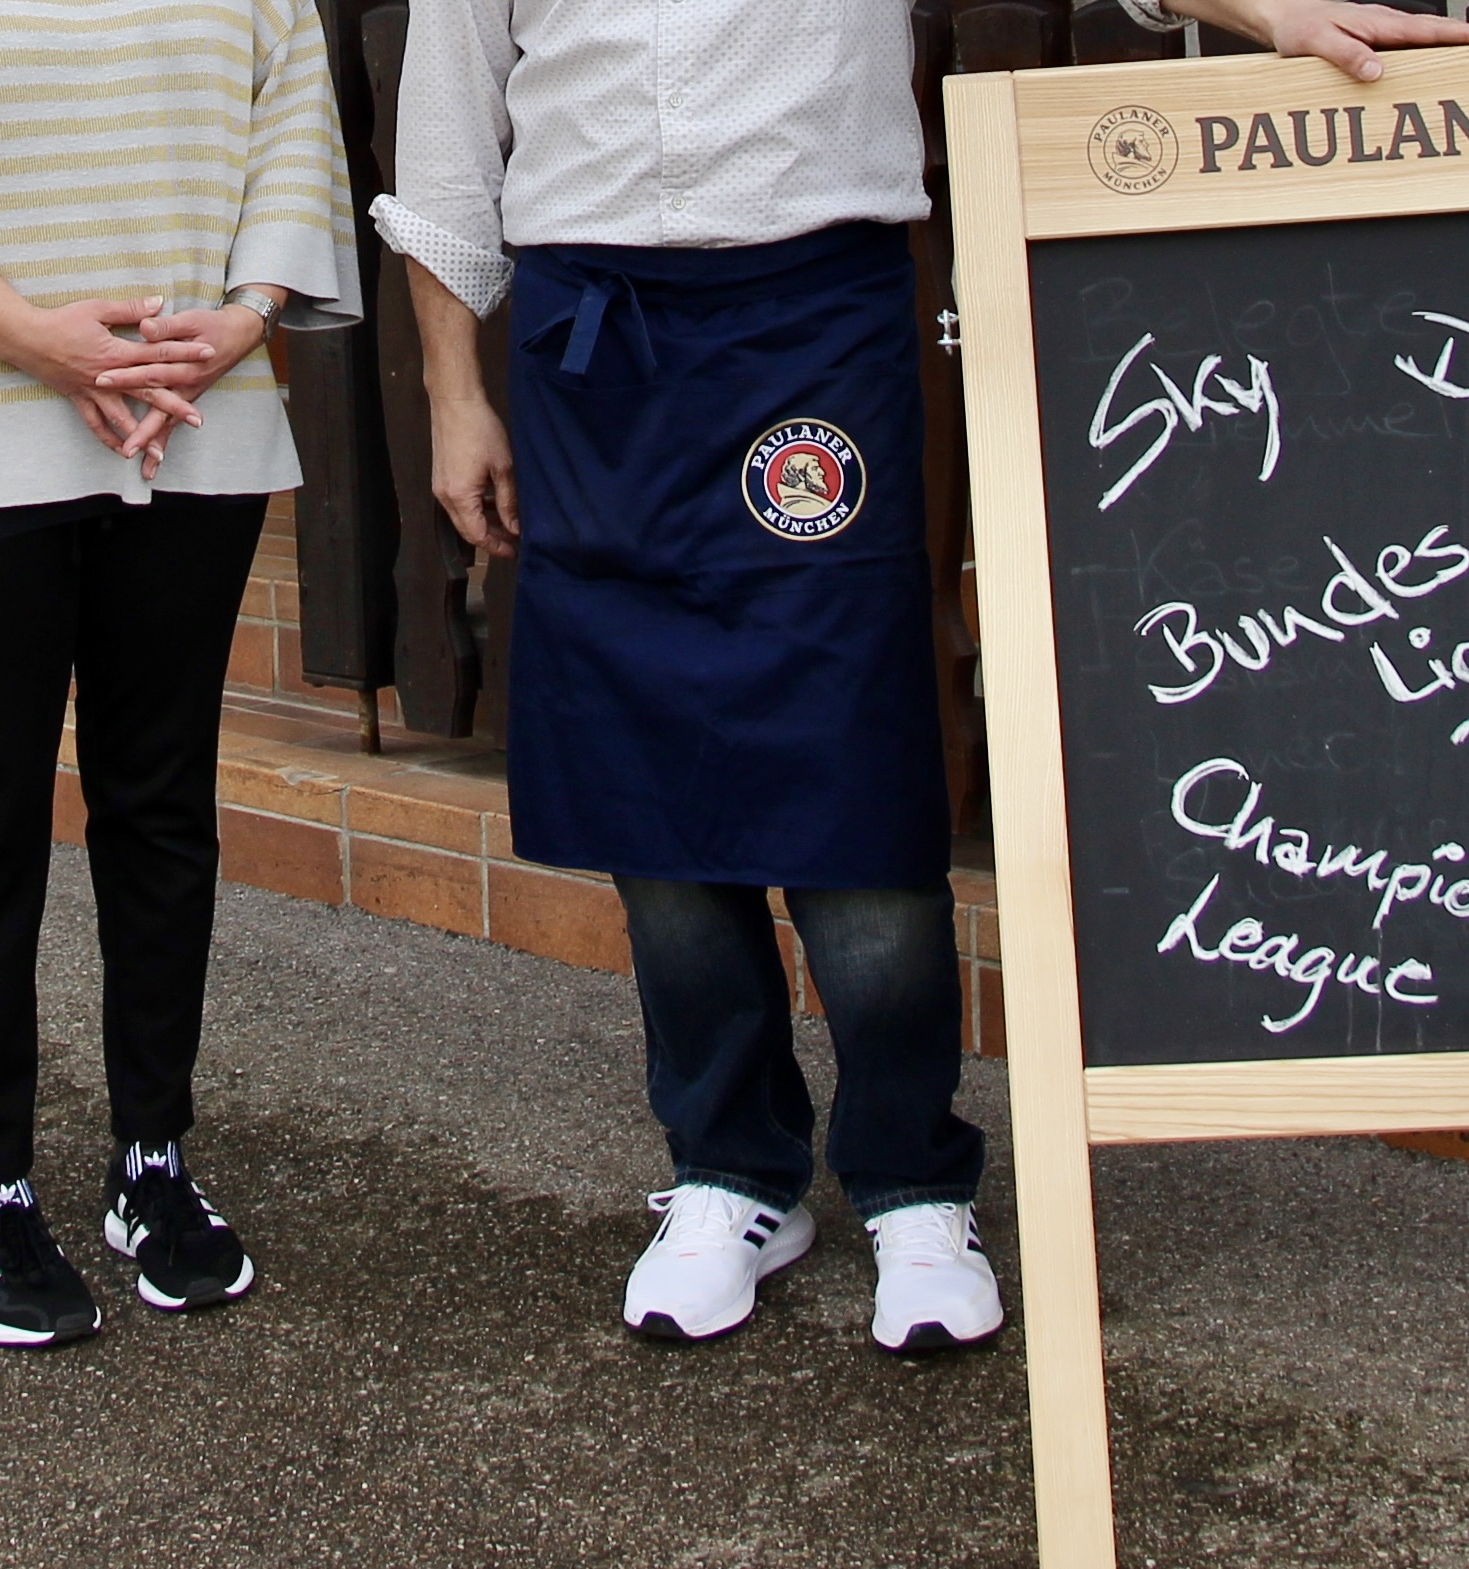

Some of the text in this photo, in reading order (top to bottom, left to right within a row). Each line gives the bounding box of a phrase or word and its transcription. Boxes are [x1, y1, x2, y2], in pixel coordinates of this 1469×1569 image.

[1093, 109, 1170, 142] PAULANER
[751, 424, 852, 470] PAULANER
[762, 502, 850, 534] MÜNCHEN
[1157, 873, 1439, 1033] League
